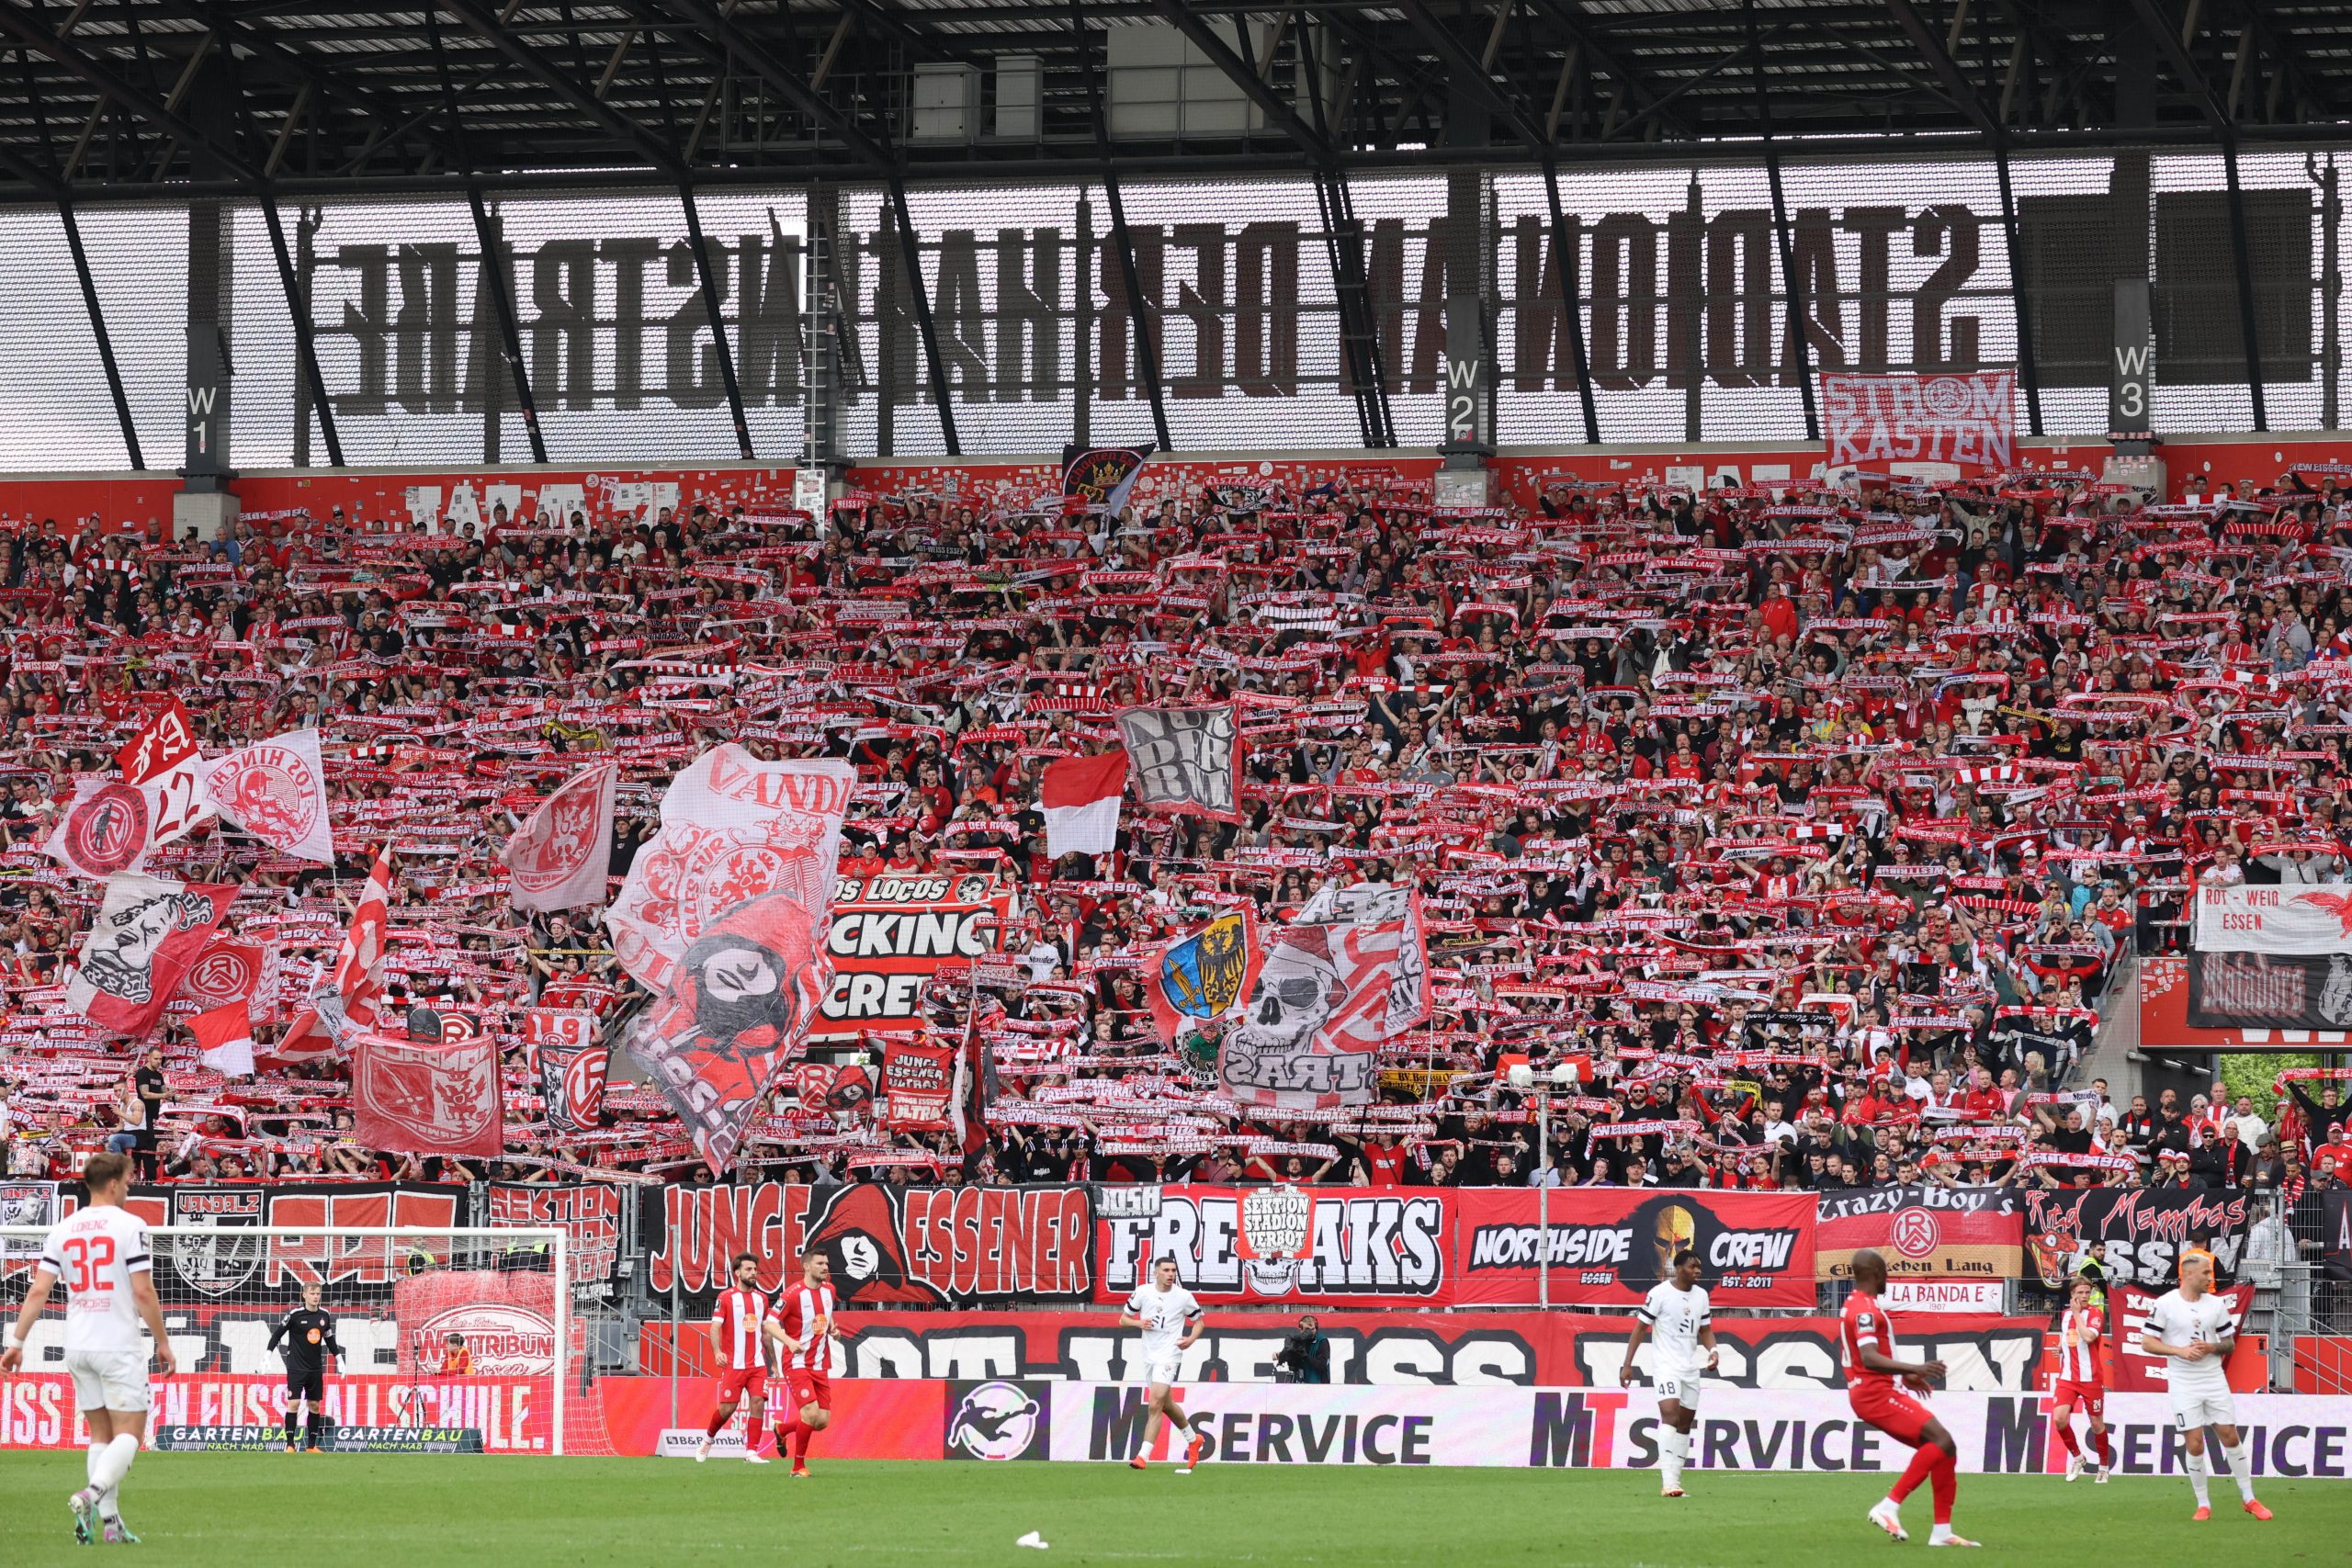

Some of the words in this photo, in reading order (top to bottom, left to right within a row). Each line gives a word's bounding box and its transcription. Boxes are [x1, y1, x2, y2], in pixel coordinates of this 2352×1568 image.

[2116, 346, 2149, 376] W
[1446, 361, 1477, 389] W
[187, 387, 217, 414] W
[2120, 382, 2144, 418] 3
[1831, 417, 2011, 467] KASTEN
[1669, 558, 1695, 568] LEBEN
[1697, 558, 1716, 569] LANG
[2253, 791, 2286, 802] MITGLIED
[969, 822, 987, 832] DER
[865, 878, 951, 904] LOCOS
[2206, 888, 2227, 906] ROT
[2222, 913, 2263, 931] ESSEN
[894, 1054, 938, 1068] JUNGE
[1248, 1107, 1294, 1122] FREAKS
[287, 1145, 316, 1155] MITGLIED
[1105, 1141, 1152, 1155] FREAKS
[1163, 1139, 1212, 1154] ULTRAS
[1964, 1149, 2002, 1160] MITGLIED
[178, 1194, 260, 1213] VANDALZ
[489, 1185, 620, 1222] SEKTION
[1098, 1186, 1161, 1213] JOSH
[1243, 1197, 1310, 1215] SEKTION
[1243, 1213, 1308, 1233] STADION
[2102, 1190, 2247, 1242] Mambas
[649, 1183, 816, 1294] JUNGE
[904, 1187, 1091, 1296] ESSENER
[1247, 1230, 1306, 1249] VERBOT
[1709, 1233, 1796, 1270] CREW
[63, 1236, 116, 1292] 32
[1946, 1258, 1994, 1275] Lang
[1580, 1271, 1614, 1285] ESSEN
[1721, 1275, 1744, 1289] EST.
[1745, 1275, 1773, 1289] 2011
[1892, 1285, 1911, 1303] LA
[1916, 1285, 1970, 1303] BANDA
[1658, 1382, 1676, 1395] 48
[337, 1427, 463, 1442] GARTENBAU
[1186, 1413, 1434, 1464] SERVICE
[1529, 1392, 1627, 1469] MT
